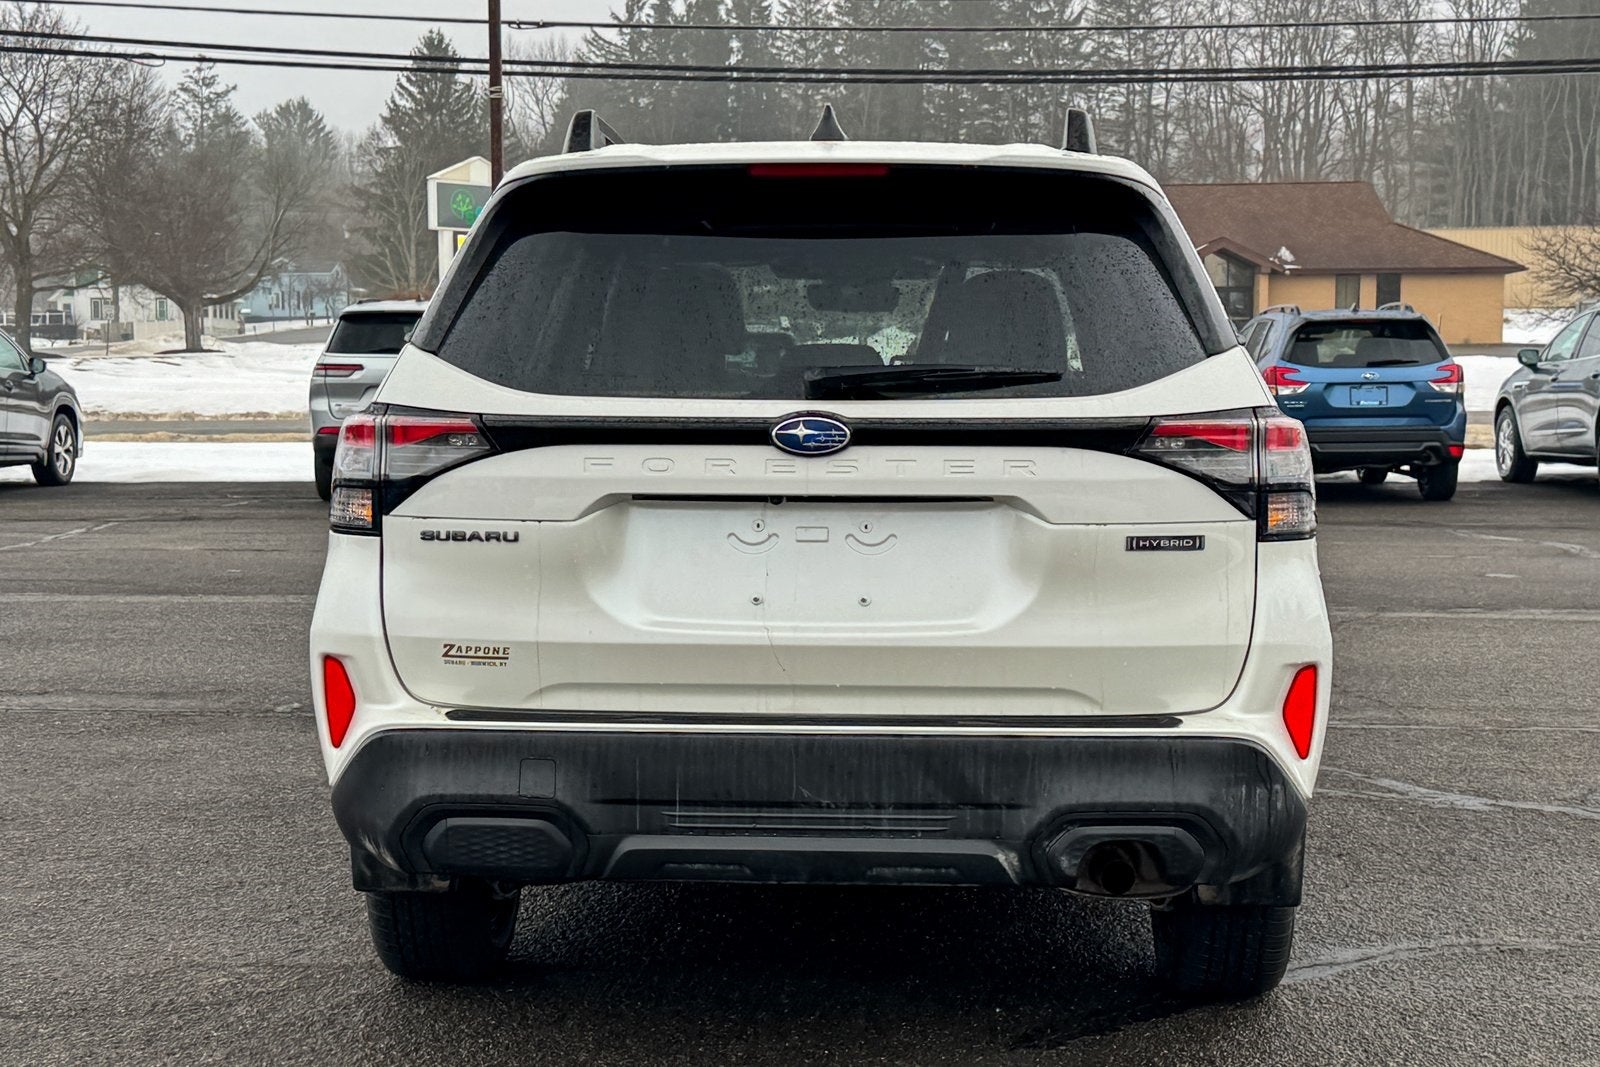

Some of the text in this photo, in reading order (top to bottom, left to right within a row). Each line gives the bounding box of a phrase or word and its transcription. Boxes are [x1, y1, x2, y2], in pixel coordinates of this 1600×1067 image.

[583, 457, 1038, 477] FORESTER
[420, 530, 520, 543] SUBARU
[1139, 539, 1194, 547] HYBRID
[441, 643, 510, 657] ZAPPONE
